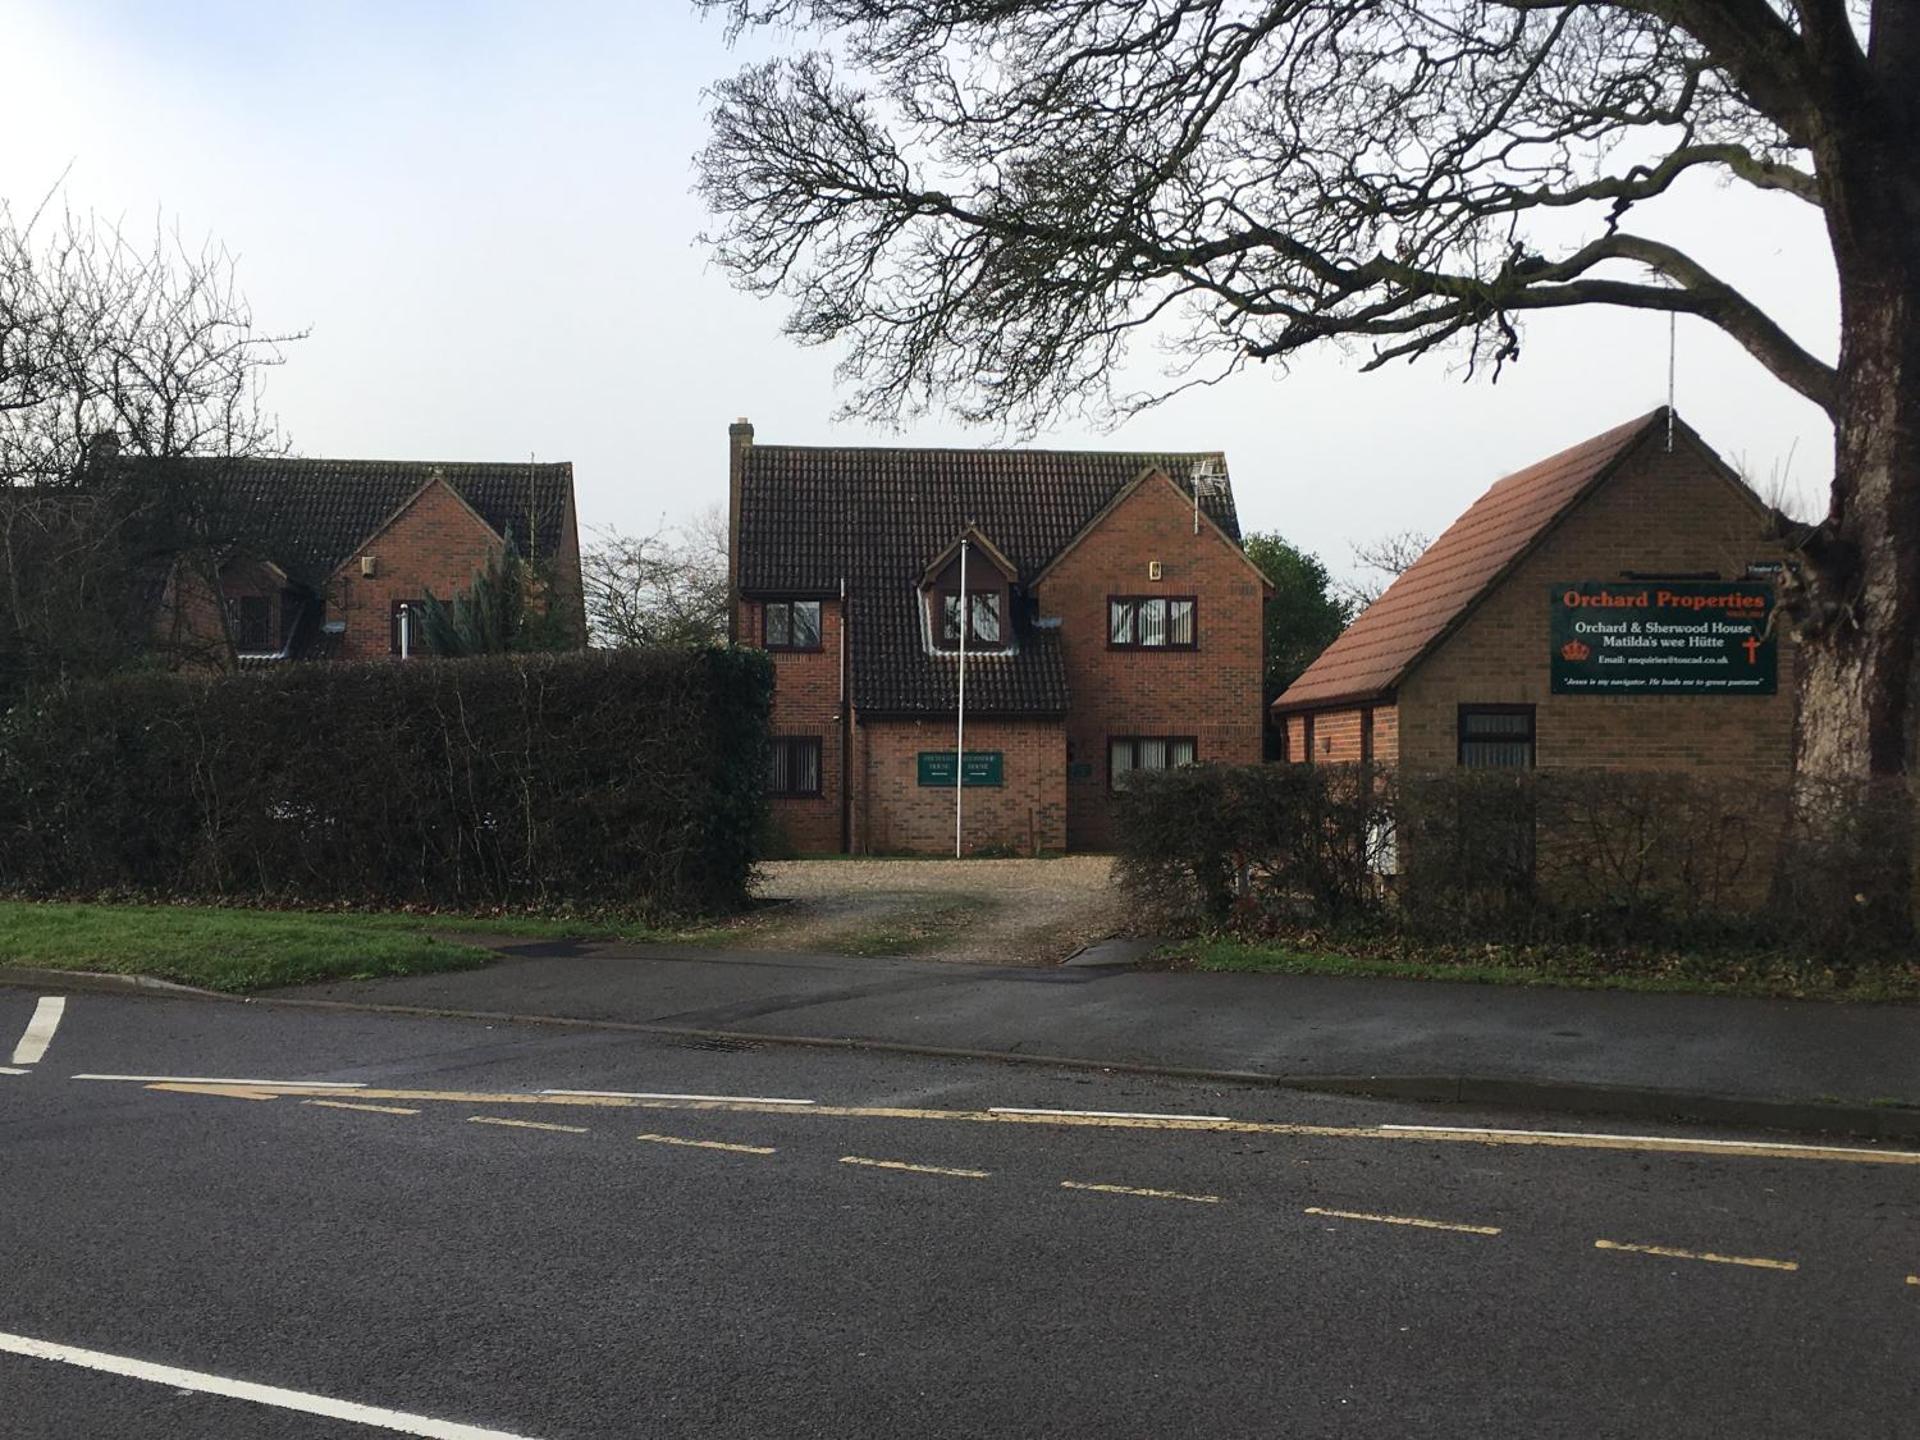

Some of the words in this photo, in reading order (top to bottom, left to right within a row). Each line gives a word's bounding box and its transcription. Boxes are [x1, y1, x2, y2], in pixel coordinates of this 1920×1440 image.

[1563, 590, 1648, 608] Orchard
[1656, 590, 1765, 611] Properties
[1575, 621, 1627, 633] Orchard
[1630, 621, 1642, 633] &
[1645, 621, 1709, 633] Sherwood
[1712, 621, 1752, 633] House
[1603, 635, 1658, 647] Matilda's
[1660, 638, 1686, 647] wee
[1689, 635, 1725, 647] Hütte
[1598, 655, 1626, 664] Email:
